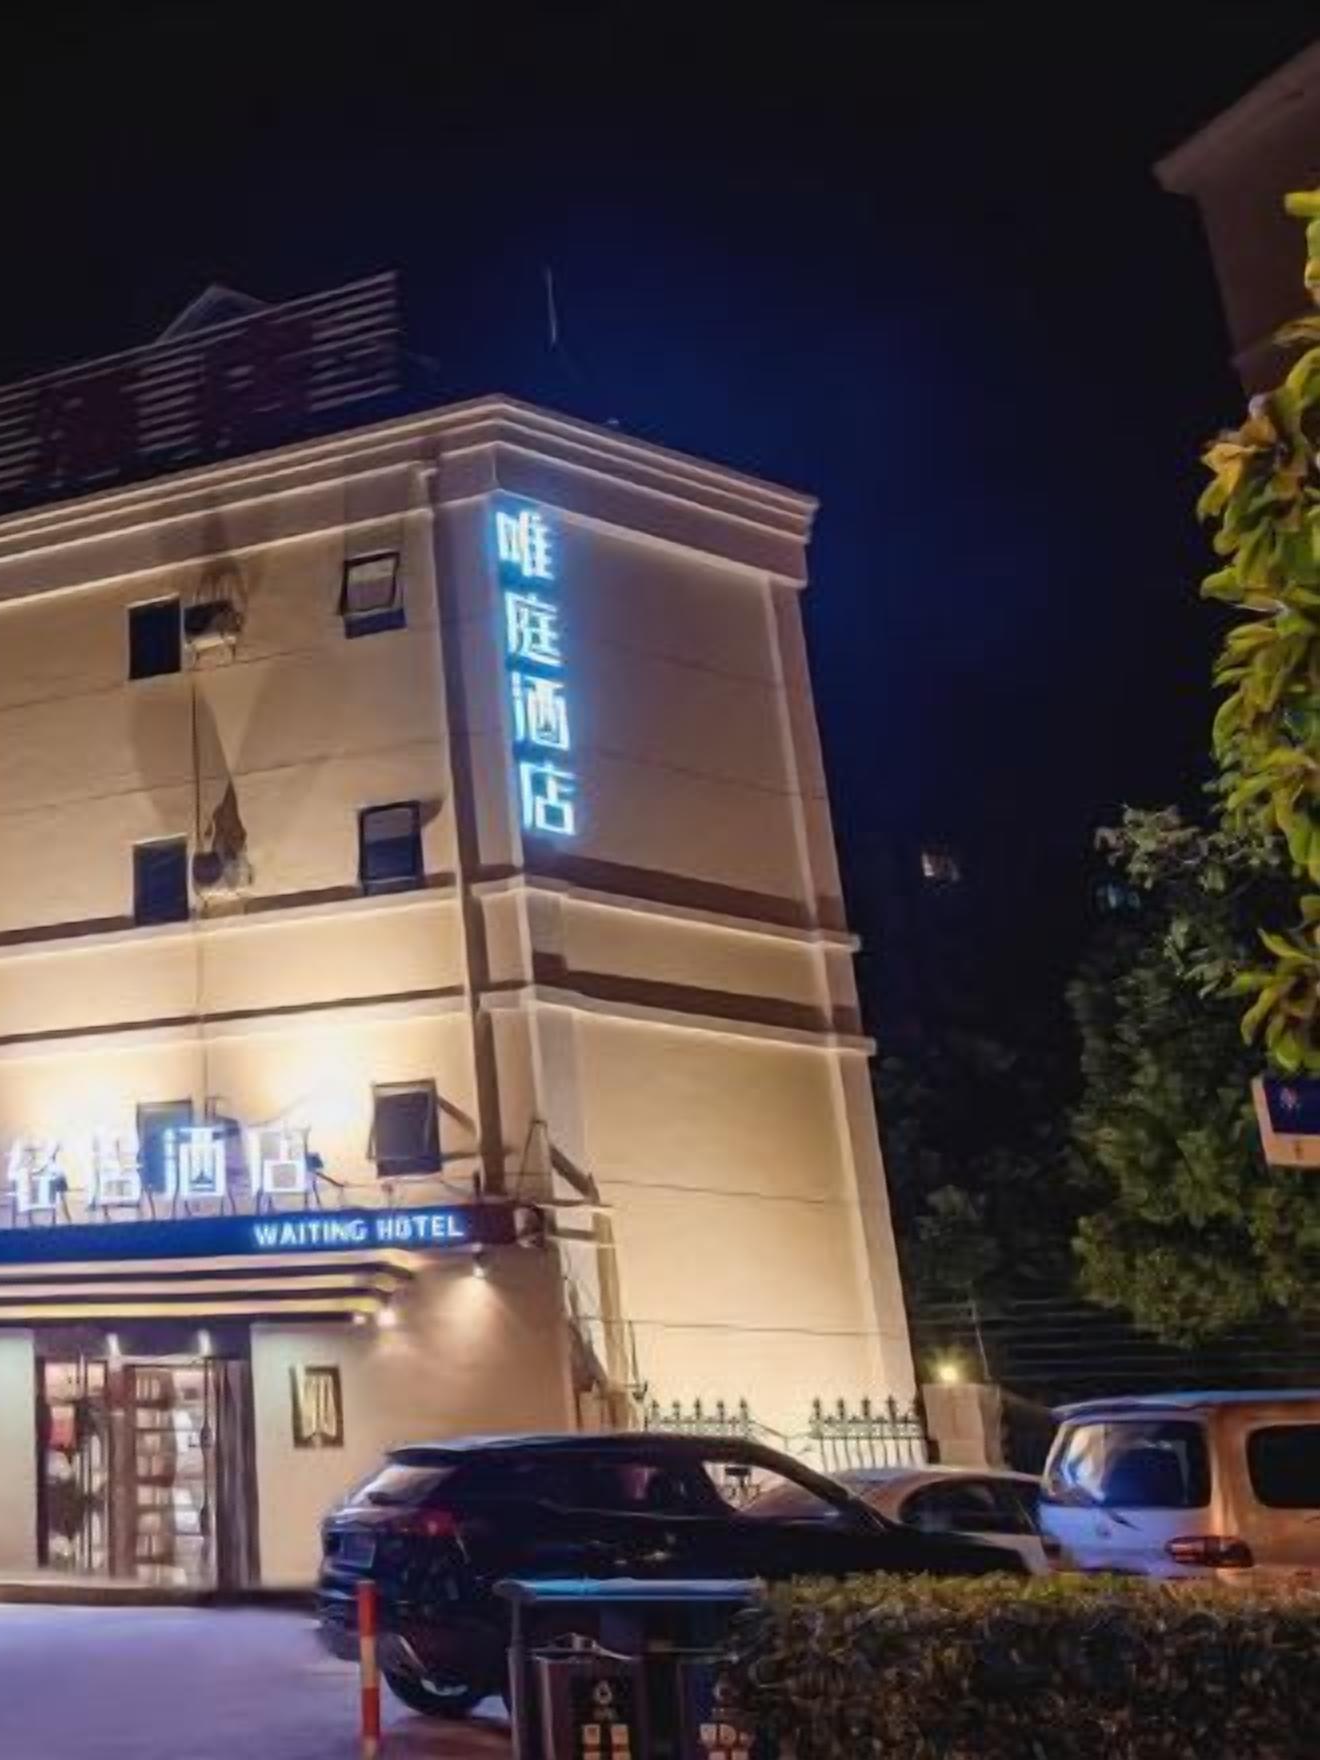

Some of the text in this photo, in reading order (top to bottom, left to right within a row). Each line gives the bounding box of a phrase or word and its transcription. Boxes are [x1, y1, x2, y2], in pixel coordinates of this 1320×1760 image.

[495, 510, 577, 836] 唯庭酒店
[253, 1214, 465, 1246] WAITING HOTEL
